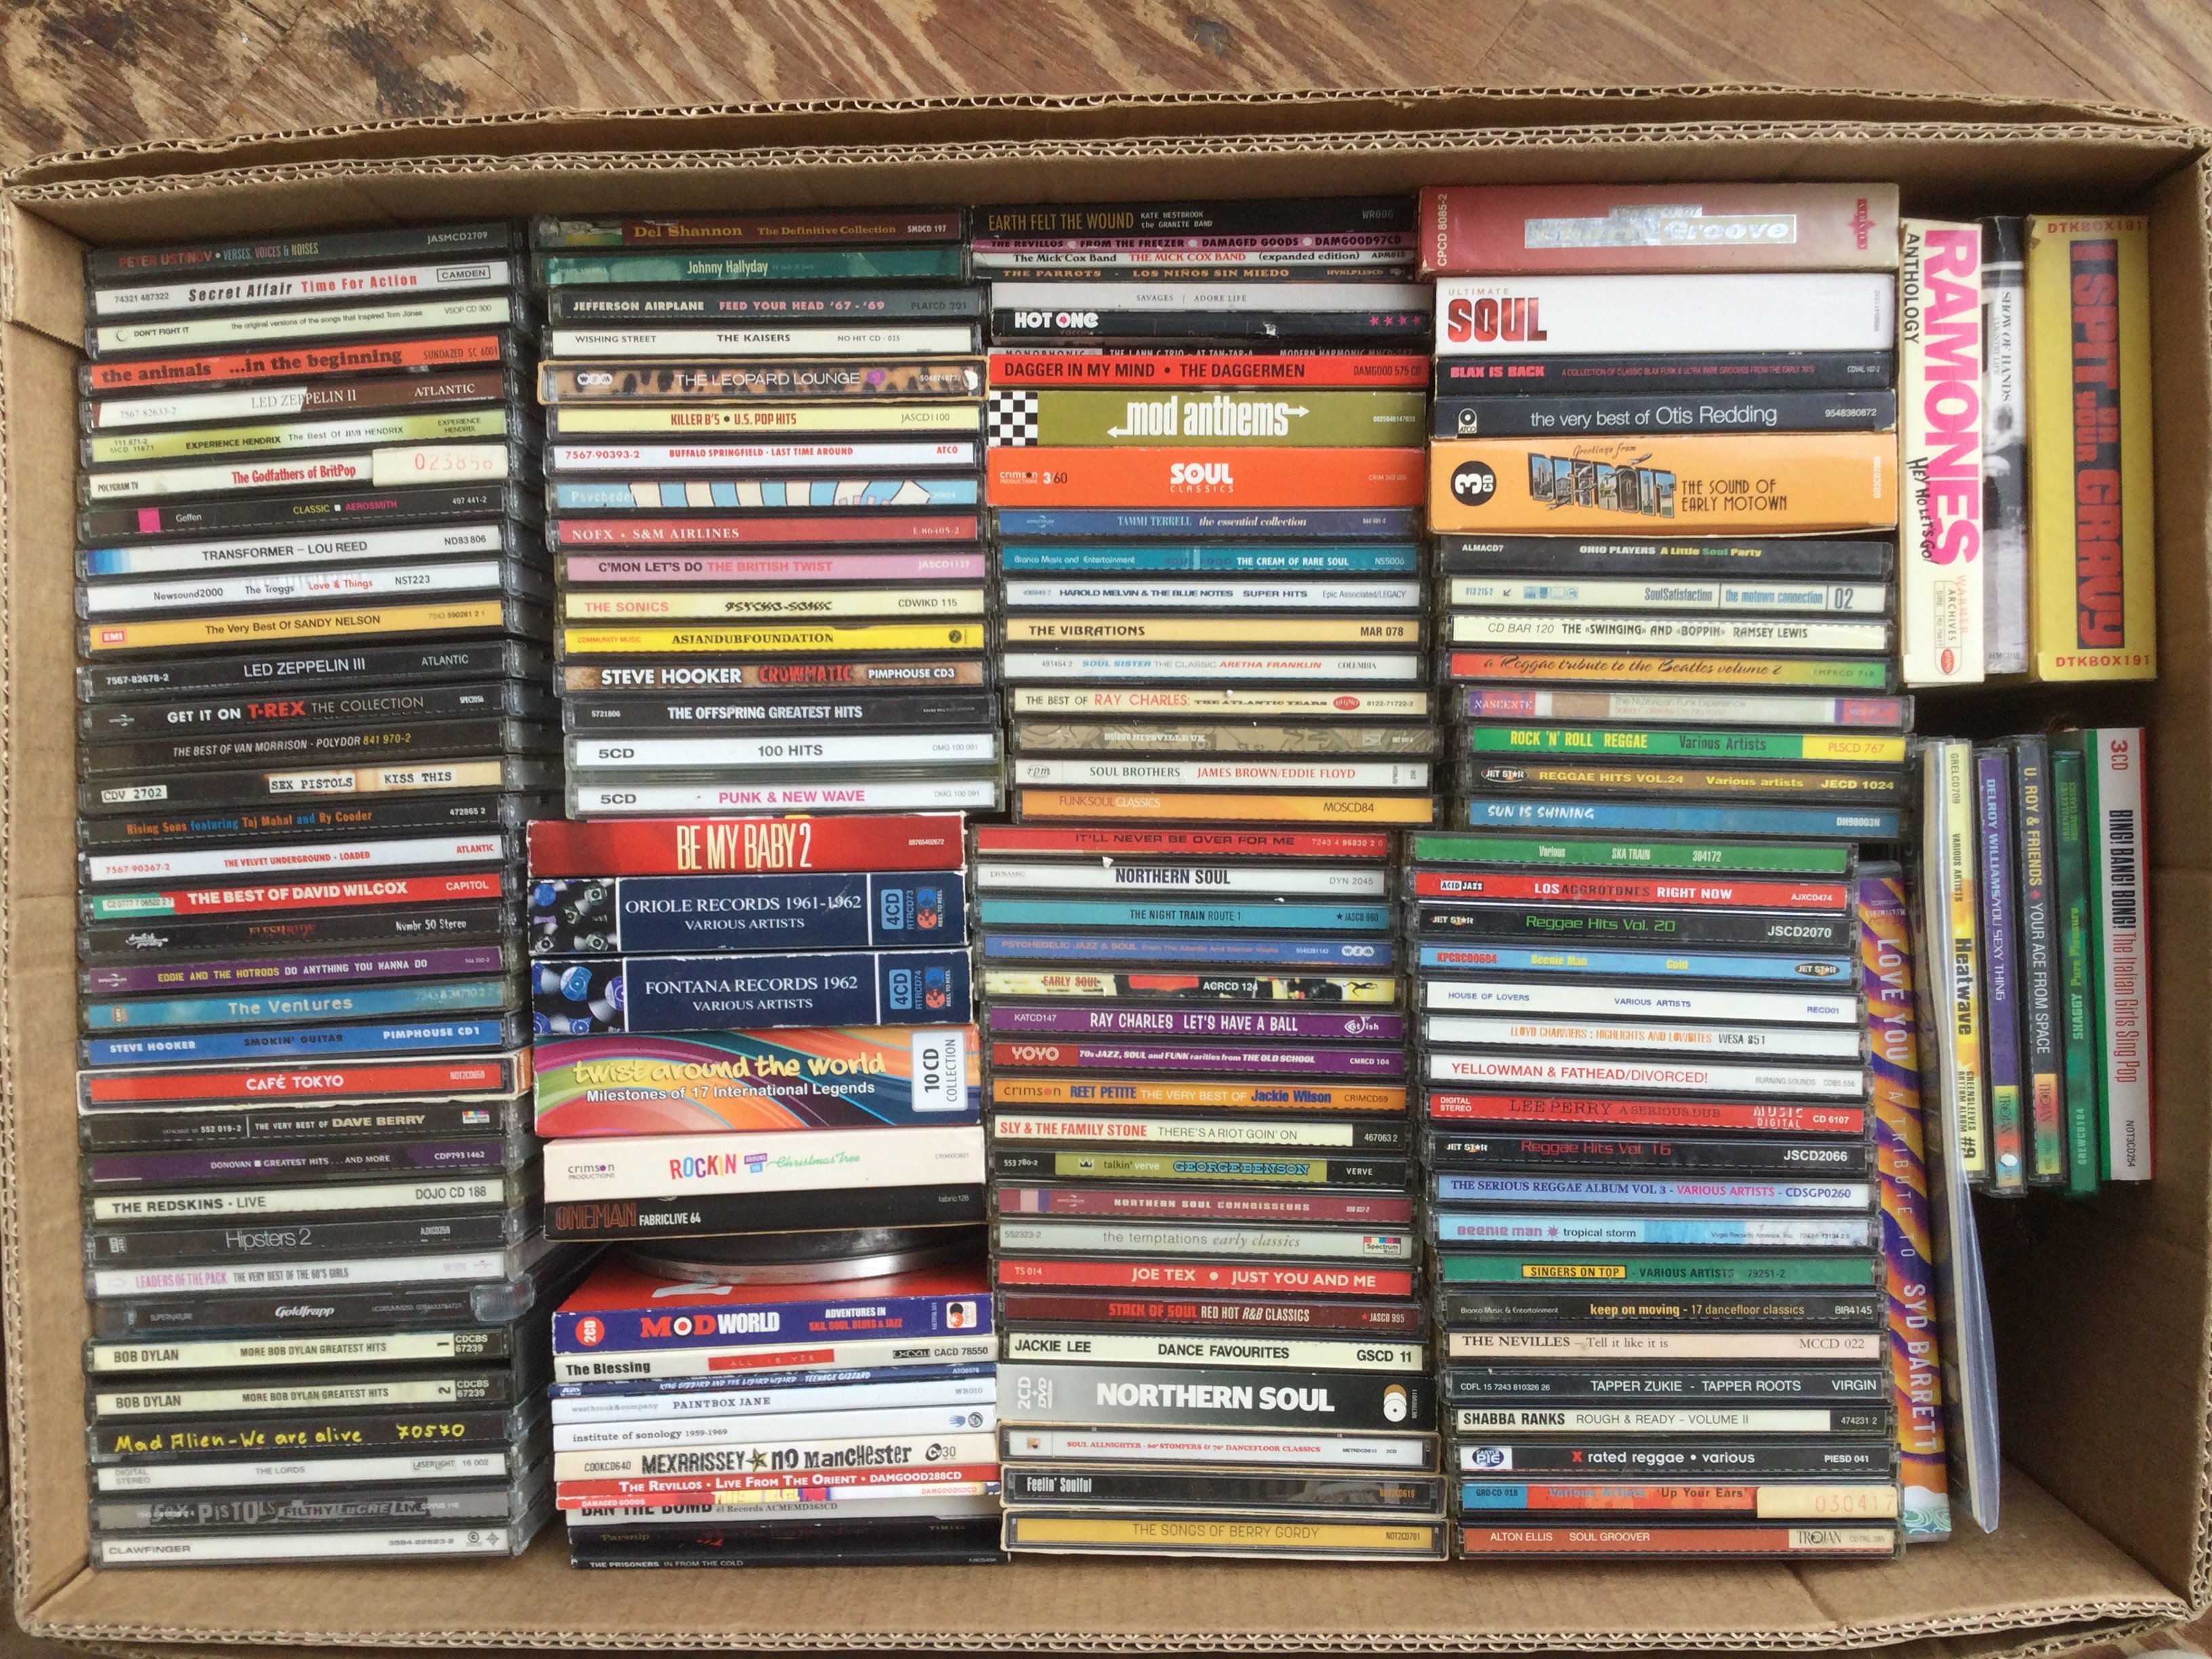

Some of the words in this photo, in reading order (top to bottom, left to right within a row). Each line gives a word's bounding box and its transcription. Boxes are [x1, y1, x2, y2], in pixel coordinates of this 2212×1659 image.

[1662, 220, 1790, 241] Groove
[442, 269, 486, 279] CAMDEN
[687, 260, 722, 276] Johnny
[726, 260, 769, 276] Hallyday
[189, 287, 243, 302] Secret
[247, 281, 293, 298] Affair
[301, 279, 335, 293] Time
[342, 276, 366, 291] For
[370, 272, 417, 288] Action
[1904, 232, 1921, 344] ANTHOLOGY
[573, 301, 640, 312] JEFFERSON
[644, 301, 704, 312] AIRPLANE
[719, 300, 748, 311] FEED
[753, 300, 787, 311] YOUR
[792, 300, 825, 311] HEAD
[1447, 297, 1547, 343] SOUL
[2073, 272, 2118, 390] SPIT
[102, 368, 132, 382] the
[138, 363, 211, 381] animals
[272, 356, 301, 371] the
[308, 349, 403, 369] beginning
[1004, 363, 1063, 377] DAGGER
[1067, 363, 1083, 377] IN
[1087, 363, 1111, 377] MY
[1114, 363, 1155, 377] MIND
[1179, 363, 1209, 377] THE
[1214, 363, 1305, 377] DAGGERMEN
[677, 374, 708, 386] THE
[712, 373, 790, 386] LEOPARD
[793, 372, 860, 385] LOUNGE
[1924, 230, 1980, 566] RAMONES
[1126, 395, 1178, 436] mod
[1183, 395, 1289, 436] anthems
[1531, 412, 1555, 428] the
[1559, 412, 1590, 428] very
[1596, 409, 1631, 427] best
[1634, 408, 1650, 426] of
[1655, 406, 1693, 426] Otis
[1699, 406, 1778, 428] Redding
[1170, 462, 1234, 485] SOUL
[1170, 485, 1234, 493] CLASSICS
[202, 545, 294, 560] TRANSFORMER
[308, 543, 333, 555] LOU
[335, 541, 367, 553] REED
[1645, 587, 1713, 602] SoulSatisfaction
[1029, 626, 1056, 636] THE
[1061, 626, 1145, 636] VIBRATIONS
[1359, 627, 1382, 637] MAR
[1385, 626, 1404, 637] 078
[2055, 655, 2151, 668] DTKBOX191
[601, 669, 656, 685] STEVE
[661, 668, 741, 684] HOOKER
[868, 668, 930, 678] PIMPHOUSE
[933, 668, 955, 678] CD3
[167, 710, 195, 724] GET
[200, 709, 213, 720] IT
[218, 707, 241, 720] ON
[312, 701, 335, 714] THE
[340, 696, 424, 712] COLLECTION
[1510, 731, 1542, 746] ROCK
[1564, 731, 1593, 747] ROLL
[1603, 733, 1647, 749] REGGAE
[598, 747, 635, 759] 5CD
[758, 745, 783, 756] 100
[787, 744, 823, 756] HITS
[2110, 739, 2129, 771] 3CD
[272, 777, 296, 790] SEX
[301, 775, 353, 789] PISTOLS
[384, 773, 415, 784] KISS
[422, 771, 452, 782] THIS
[1090, 766, 1120, 777] SOUL
[1123, 766, 1181, 778] BROTHERS
[2109, 810, 2134, 844] BING!
[677, 825, 701, 870] BE
[706, 824, 738, 869] MY
[744, 824, 796, 868] BABY
[799, 823, 811, 867] 2
[1115, 868, 1189, 884] NORTHERN
[1195, 869, 1231, 885] SOUL
[2110, 848, 2135, 886] BANG!
[187, 892, 220, 905] THE
[224, 889, 265, 904] BEST
[268, 888, 289, 901] OF
[293, 886, 339, 900] DAVID
[342, 881, 407, 897] WILCOX
[446, 881, 489, 892] CAPITOL
[626, 899, 693, 914] ORIOLE
[697, 897, 780, 912] RECORDS
[785, 895, 861, 911] 1961-1962
[885, 893, 901, 926] 4CD
[2112, 890, 2136, 928] BONG!
[1767, 924, 1832, 939] JSCD2070
[1876, 938, 1905, 1002] LOVE
[1953, 937, 1971, 1036] Heatwave
[228, 1002, 260, 1016] The
[268, 997, 352, 1014] Ventures
[1014, 1013, 1057, 1023] KATCD147
[1090, 1012, 1114, 1028] RAY
[1118, 1013, 1174, 1029] CHARLES
[1183, 1015, 1216, 1030] LET'S
[1221, 1015, 1253, 1031] HAVE
[1256, 1016, 1265, 1031] A
[1269, 1016, 1298, 1032] BALL
[1882, 1012, 1910, 1061] YOU
[573, 1059, 651, 1084] twist
[650, 1057, 750, 1080] around
[755, 1055, 801, 1077] the
[807, 1052, 886, 1076] world
[1451, 1063, 1543, 1078] YELLOWMAN
[1547, 1065, 1557, 1078] &
[1560, 1066, 1708, 1084] FATHEAD/DIVORCED!
[247, 1073, 287, 1090] CAFÉ
[291, 1074, 344, 1088] TOKYO
[112, 1202, 142, 1214] THE
[146, 1198, 224, 1212] REDSKINS
[237, 1196, 266, 1209] LIVE
[226, 1229, 295, 1248] Hipsters
[300, 1228, 312, 1245] 2
[1366, 1243, 1399, 1251] Spectrum
[274, 1305, 335, 1319] Goldfrapp
[825, 1307, 875, 1319] ADVENTURES
[876, 1307, 886, 1317] IN
[1903, 1284, 1928, 1329] SYD
[1015, 1340, 1061, 1353] JACKIE
[1066, 1340, 1091, 1353] LEE
[1158, 1343, 1204, 1356] DANCE
[1209, 1345, 1290, 1359] FAVOURITES
[566, 1364, 592, 1378] The
[595, 1359, 651, 1376] Blessing
[1832, 1379, 1877, 1391] VIRGIN
[1096, 1382, 1254, 1410] NORTHERN
[1258, 1387, 1335, 1412] SOUL
[1907, 1341, 1937, 1450] BARRETT
[1463, 1412, 1516, 1425] SHABBA
[1521, 1412, 1565, 1425] RANKS
[115, 1435, 163, 1454] Mad
[276, 1431, 307, 1445] are
[316, 1428, 363, 1444] alive
[396, 1422, 466, 1439] 70570
[1587, 1450, 1626, 1464] rated
[1632, 1452, 1685, 1466] reggae
[1702, 1452, 1755, 1464] various
[869, 1471, 962, 1482] DAMGOOD288CD
[1490, 1532, 1523, 1542] ALTON
[1525, 1532, 1553, 1542] ELLIS
[108, 1544, 191, 1555] CLAWFINGER
